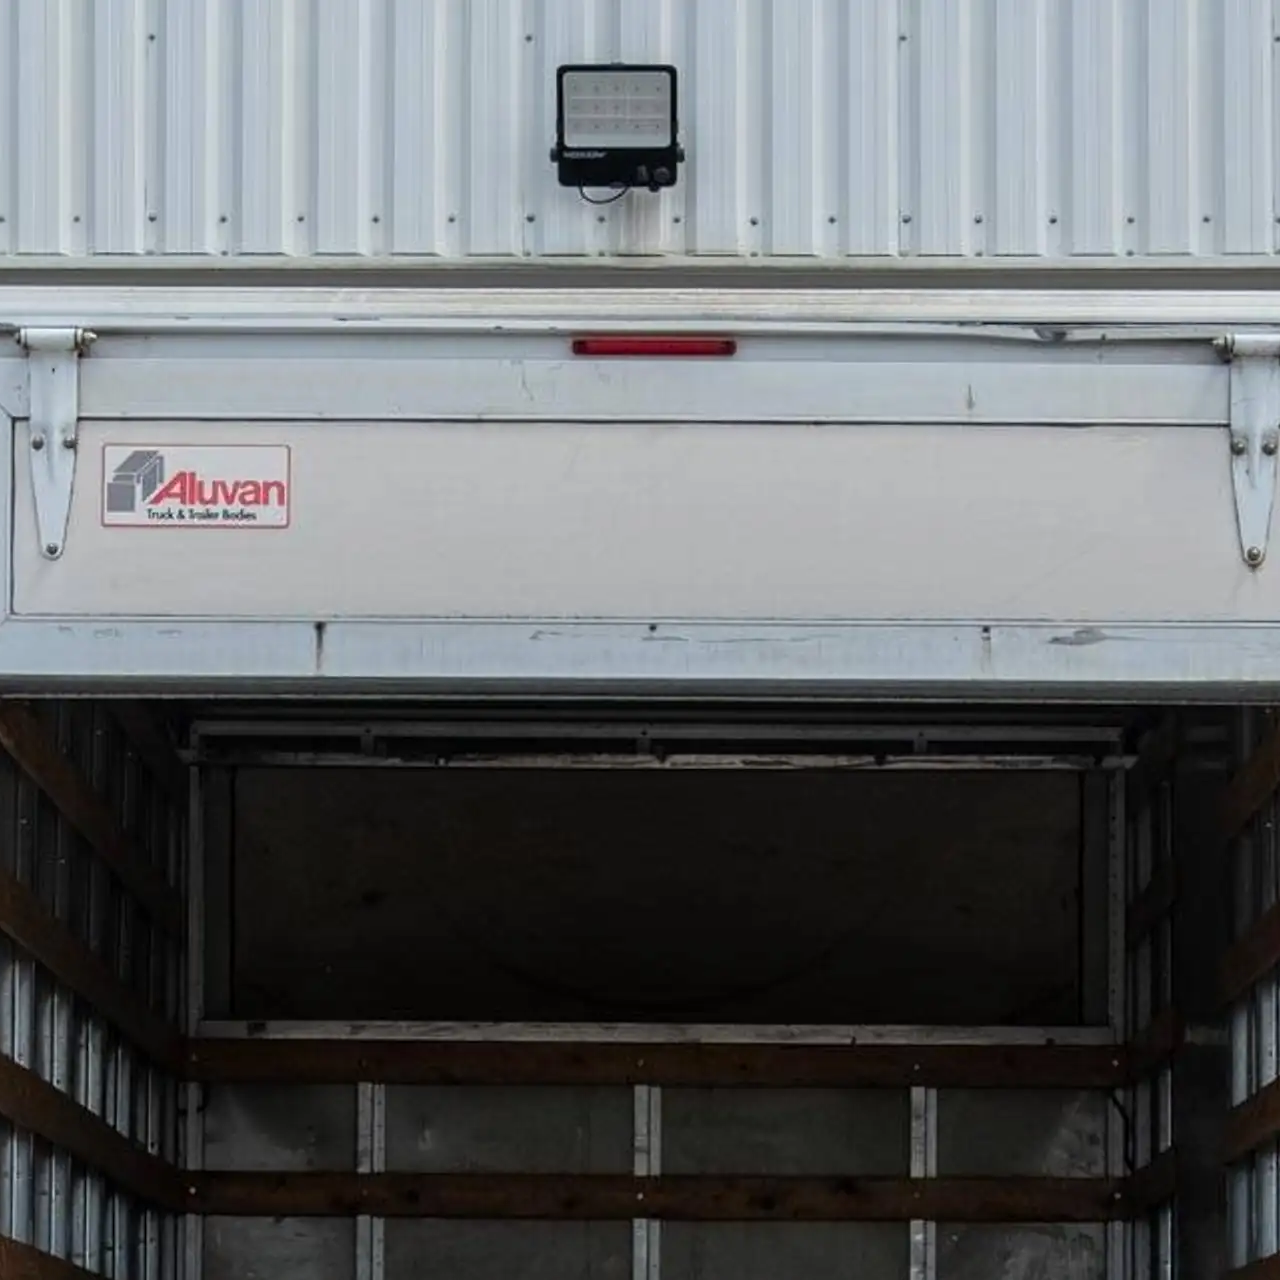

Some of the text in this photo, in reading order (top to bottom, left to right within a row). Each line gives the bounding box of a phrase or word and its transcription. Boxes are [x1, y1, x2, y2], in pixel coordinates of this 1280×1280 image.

[148, 471, 286, 506] Aluvan
[147, 507, 257, 520] Truck & Trailer Bodies
